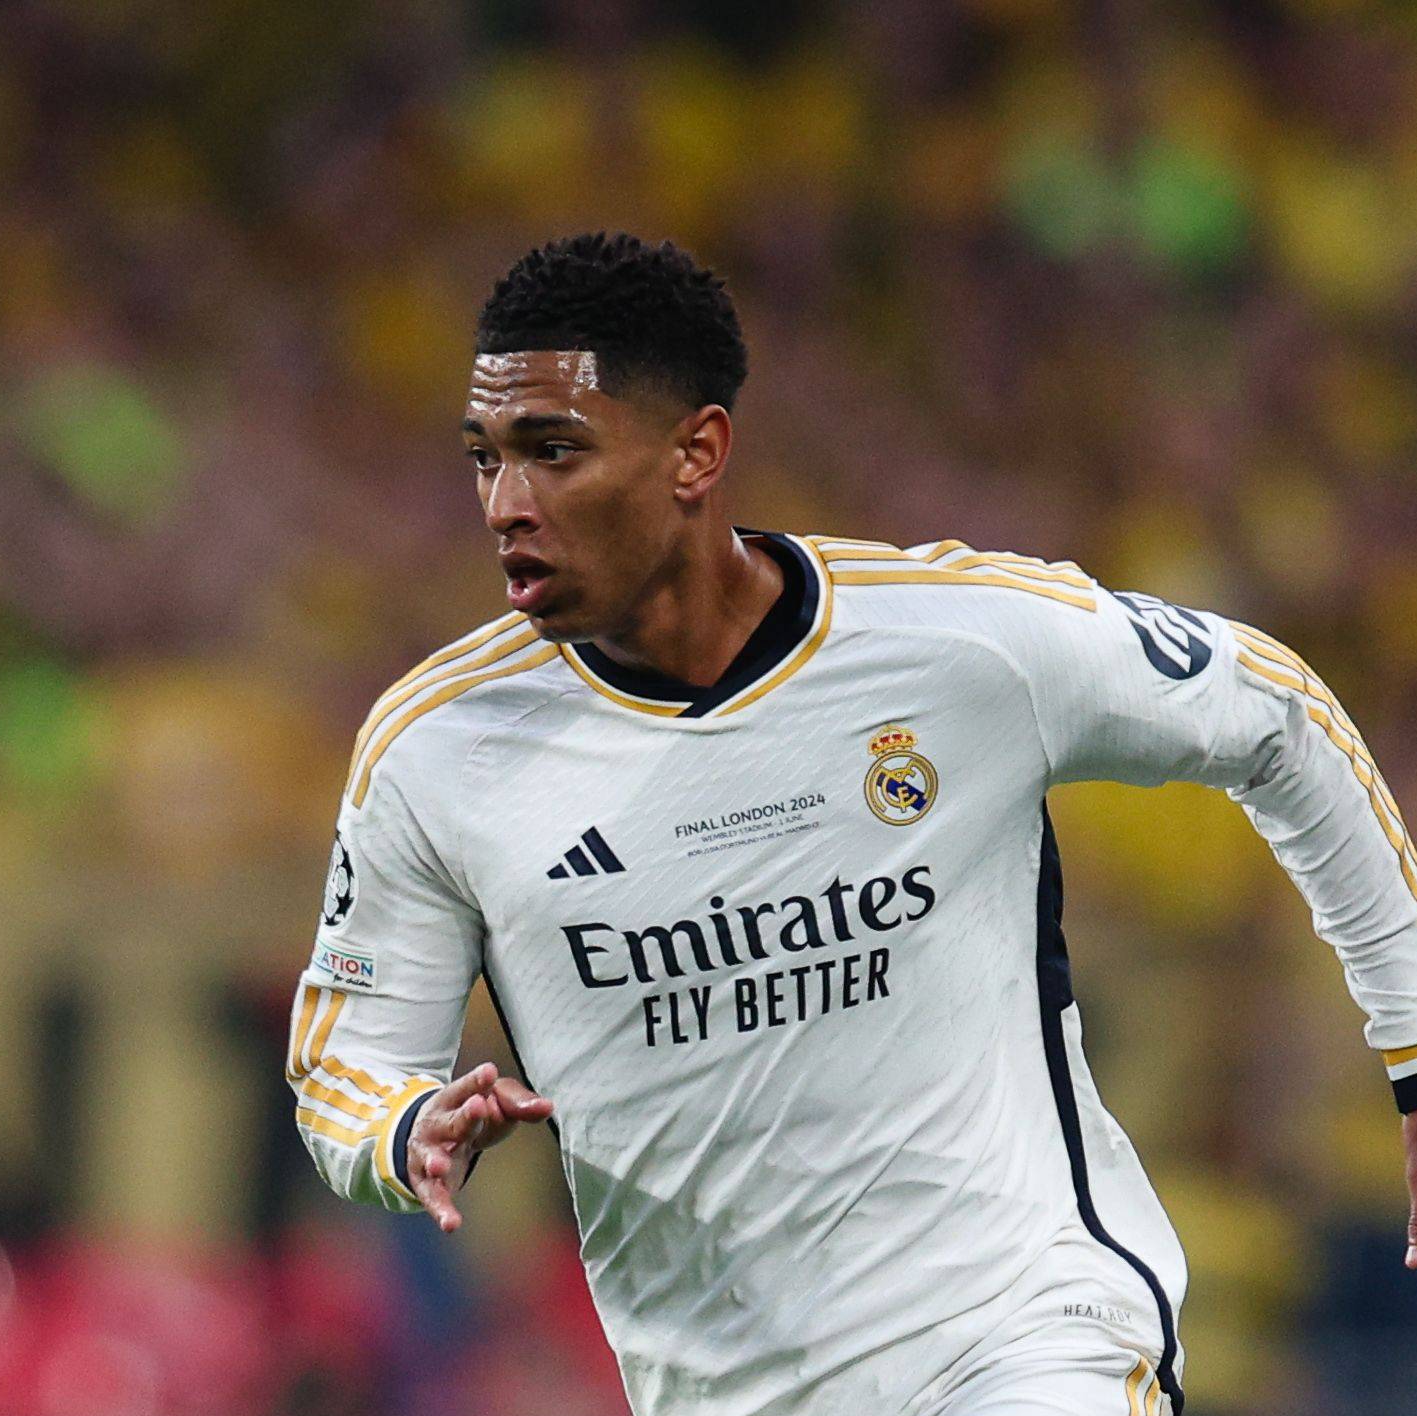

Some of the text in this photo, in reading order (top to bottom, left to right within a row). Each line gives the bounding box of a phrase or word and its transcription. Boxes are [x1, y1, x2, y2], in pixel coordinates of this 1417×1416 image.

[675, 793, 827, 838] FINAL LONDON 2024
[560, 864, 937, 989] Emirates
[644, 947, 891, 1047] FLY BETTER
